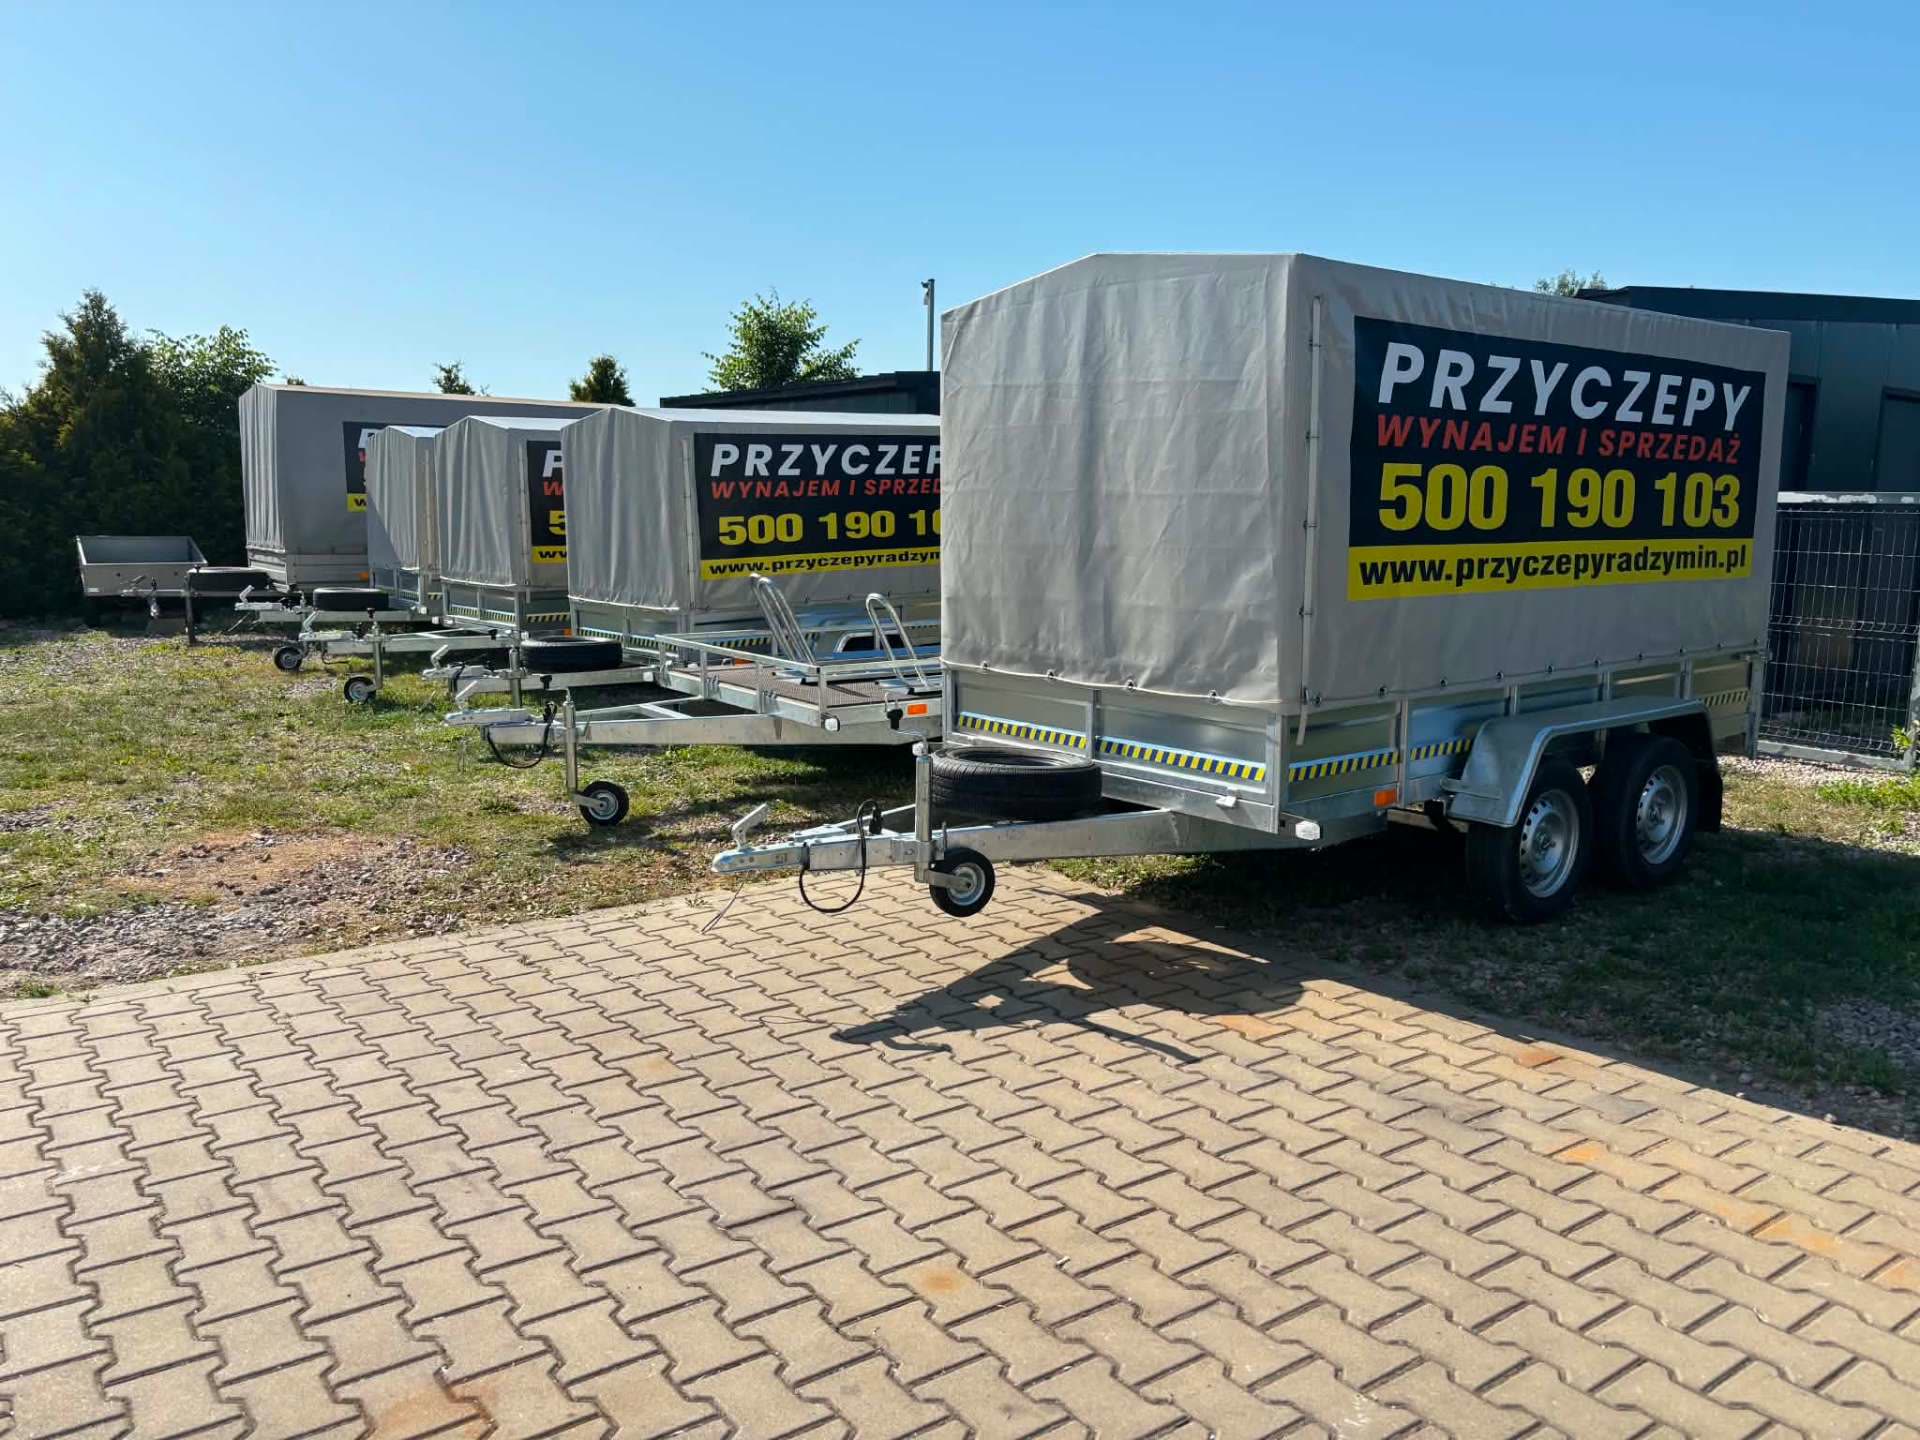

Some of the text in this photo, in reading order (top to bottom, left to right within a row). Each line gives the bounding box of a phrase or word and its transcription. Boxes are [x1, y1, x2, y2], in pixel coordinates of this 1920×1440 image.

[1378, 342, 1752, 431] PRZYCZEPY
[1377, 414, 1741, 464] WYNAJEM I SPRZEDAŻ
[711, 480, 840, 499] WYNAJEM
[1379, 463, 1740, 530] 500 190 103
[719, 513, 803, 546] 500
[818, 510, 896, 540] 190
[1360, 545, 1746, 587] www.przyczepyradzymin.pl
